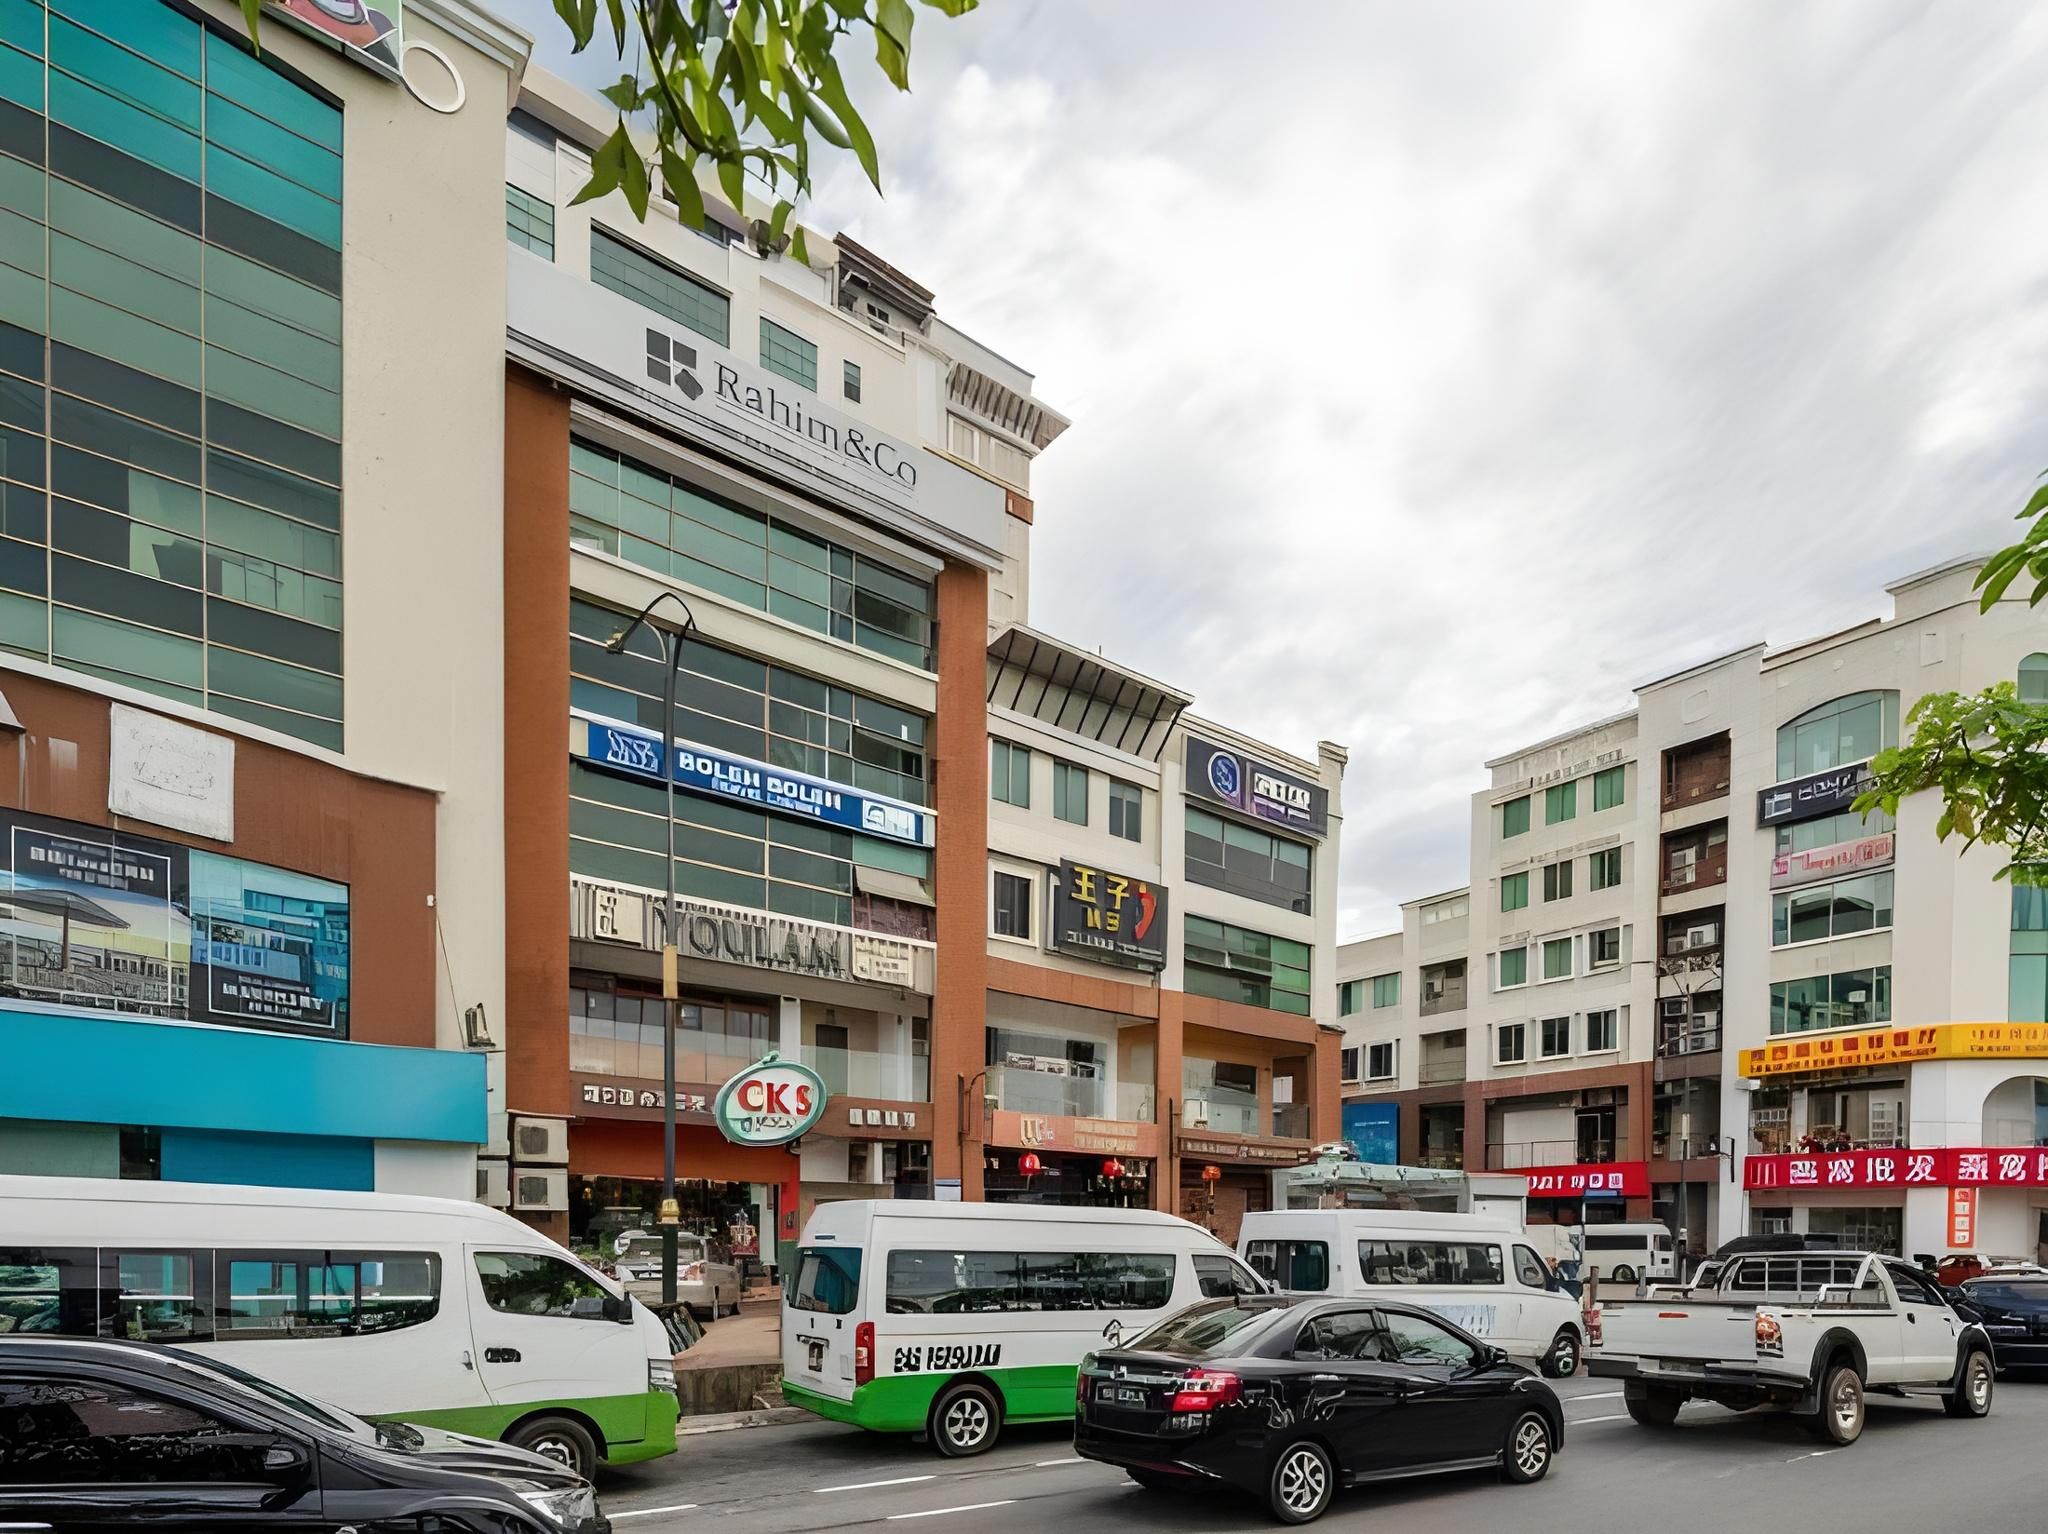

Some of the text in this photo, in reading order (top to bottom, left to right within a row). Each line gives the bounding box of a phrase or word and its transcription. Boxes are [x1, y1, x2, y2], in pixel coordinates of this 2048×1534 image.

[714, 361, 916, 486] Rahim&Co
[1071, 866, 1130, 910] 王子
[737, 1080, 813, 1117] CKS
